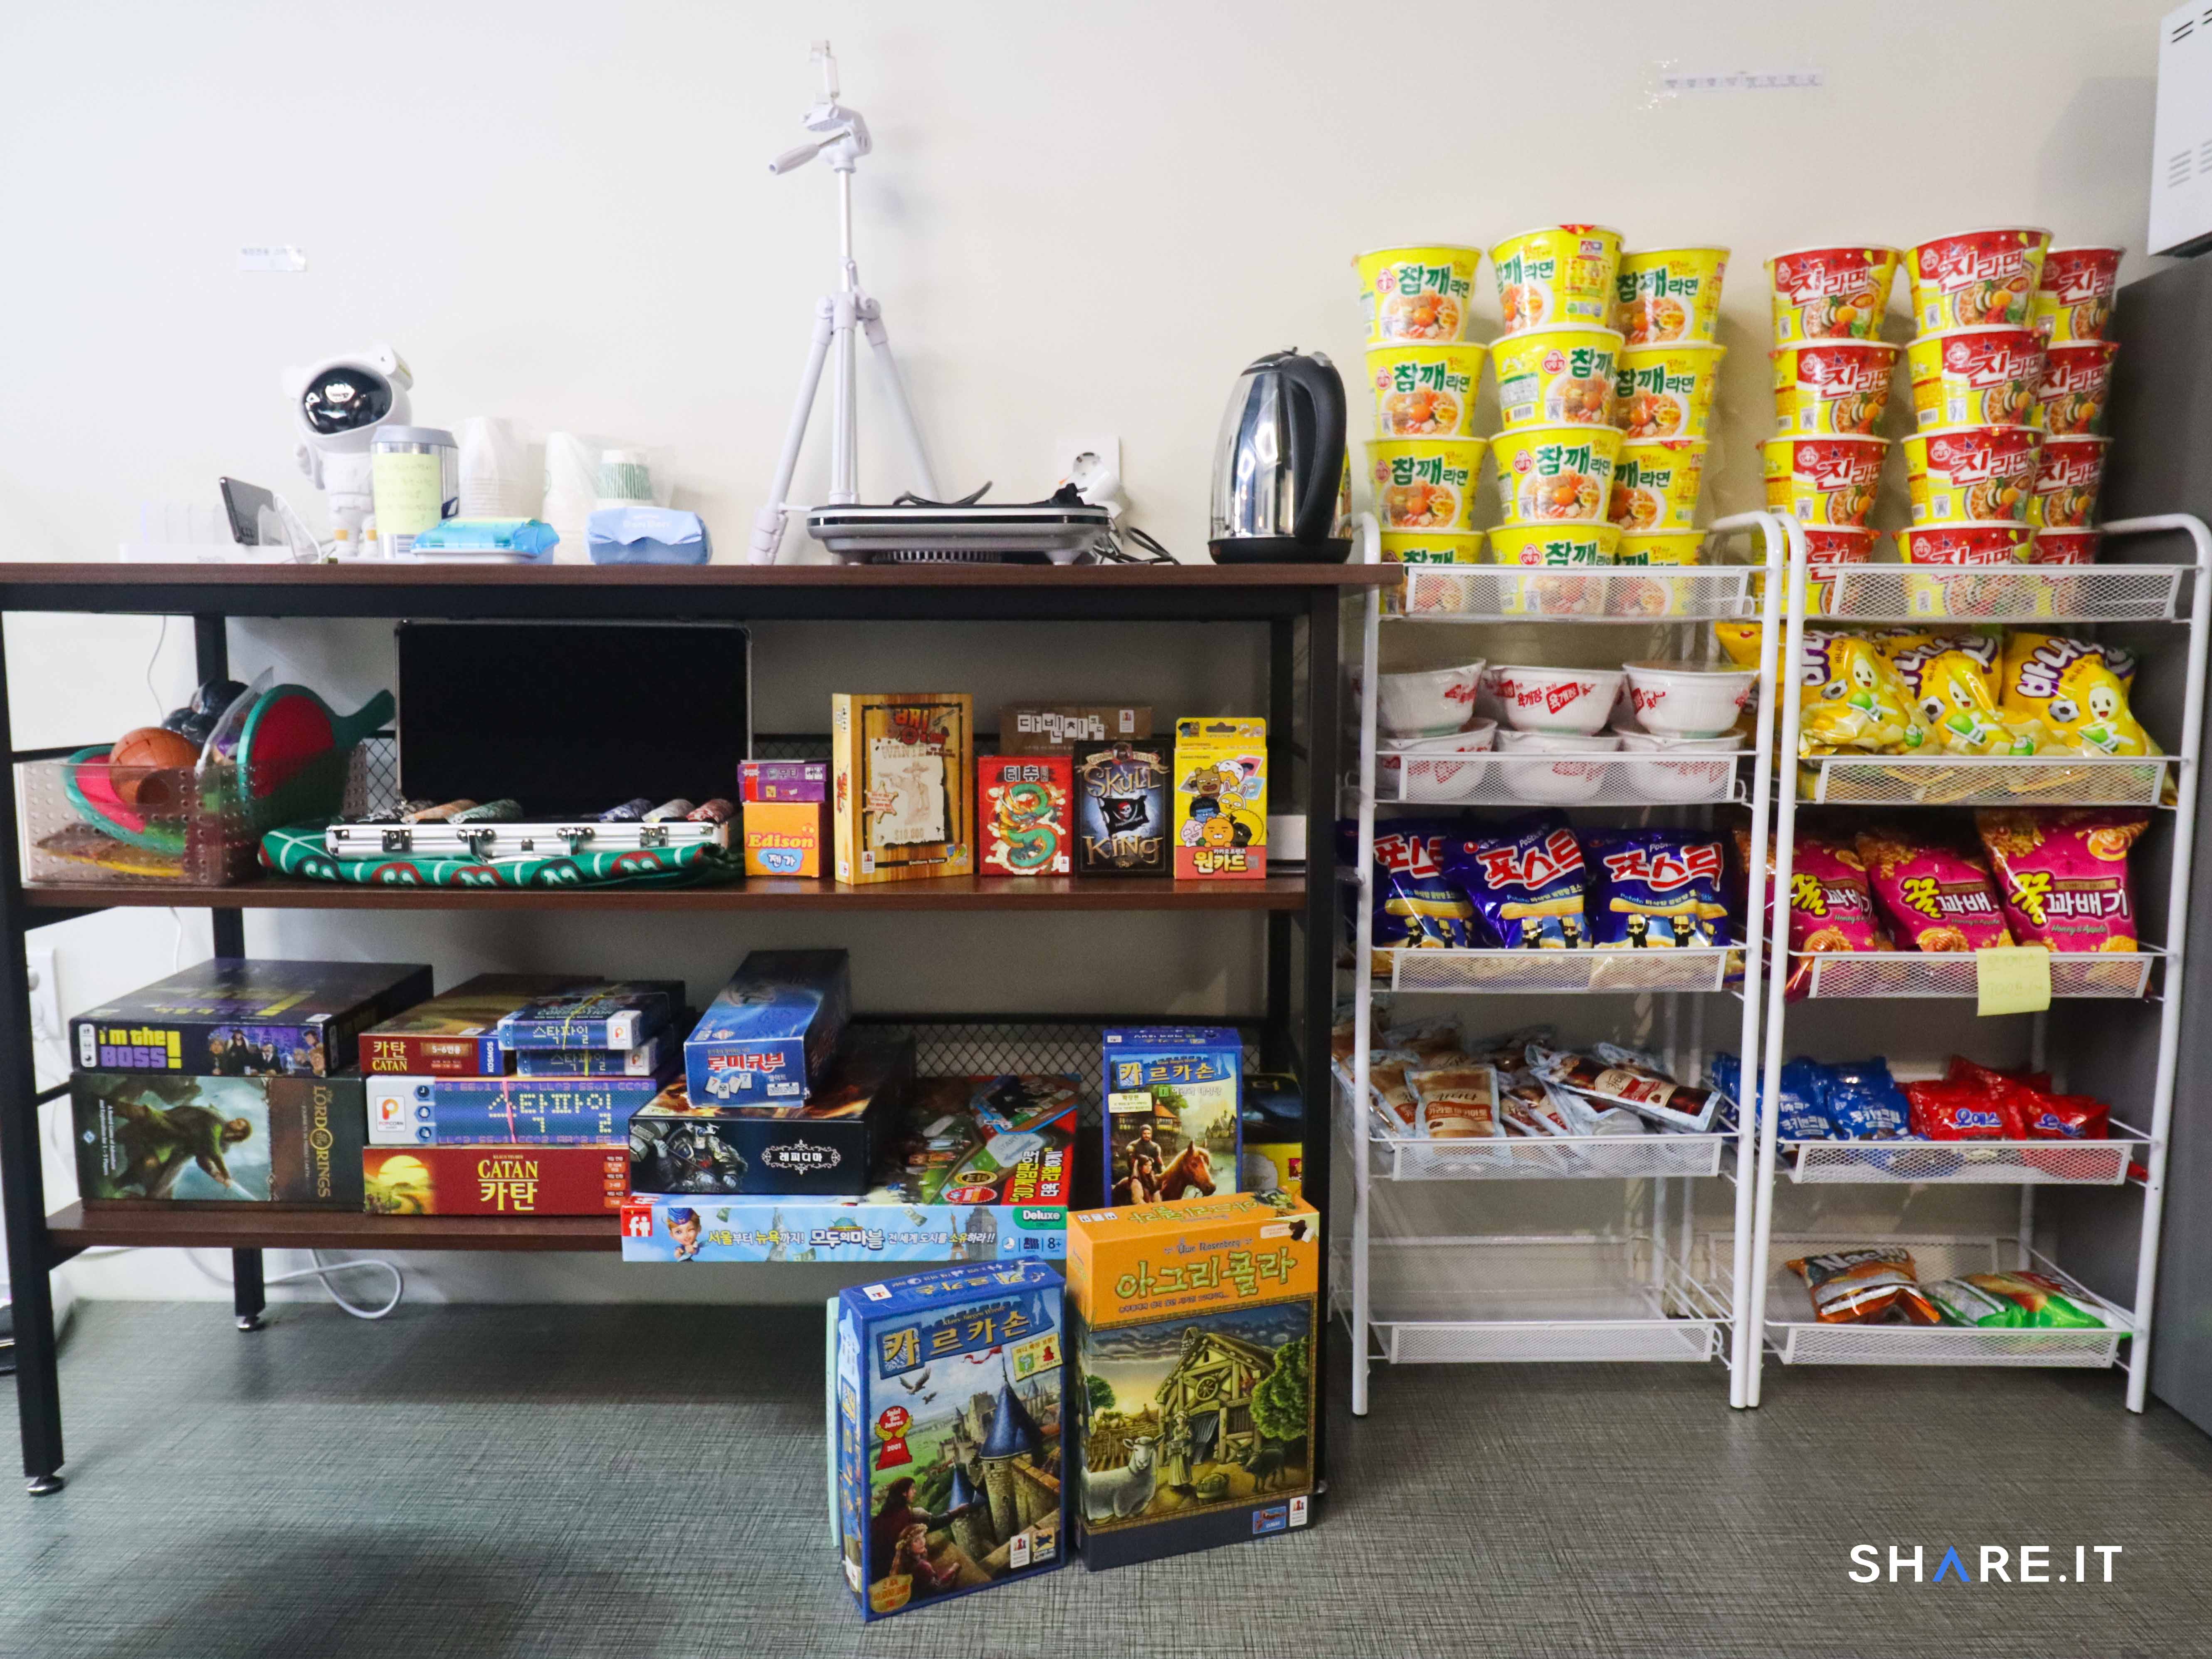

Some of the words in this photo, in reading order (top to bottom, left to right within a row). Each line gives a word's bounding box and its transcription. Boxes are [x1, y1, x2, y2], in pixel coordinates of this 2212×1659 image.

[1398, 265, 1470, 299] 참깨라면
[1938, 250, 2024, 295] 진라면
[1617, 269, 1698, 304] 참깨라면
[1790, 267, 1868, 308] 진라면
[2057, 269, 2116, 308] 진라
[1570, 348, 1617, 380] 참깨
[1394, 362, 1470, 393] 참깨라면
[1616, 363, 1695, 398] 참깨라면
[1392, 457, 1468, 487] 참깨라면
[1536, 444, 1611, 477] 참깨라면
[1615, 460, 1671, 488] 깨라면
[1549, 687, 1577, 710] 육개장
[881, 744, 926, 758] WANTE
[1004, 765, 1039, 781] 티츄
[748, 834, 814, 848] Edison
[768, 852, 796, 866] 젠가
[1193, 851, 1249, 874] 원카드
[1603, 842, 1723, 892] 포스틱
[1903, 878, 2000, 918] 꿀꽈배
[2010, 872, 2128, 924] 꿀꽈배기
[130, 1027, 165, 1046] the
[373, 1041, 407, 1059] 카탄
[372, 1060, 408, 1071] CATAN
[708, 1052, 785, 1073] 루미큐브
[1119, 1062, 1215, 1086] 카르카손
[1198, 1087, 1222, 1096] 대성당
[313, 1085, 328, 1129] LORD
[488, 1094, 612, 1133] 스탁파일
[1953, 1107, 2002, 1129] 오예스
[477, 1160, 538, 1179] CATAN
[779, 1152, 823, 1163] 레피디마
[316, 1150, 331, 1198] RINGS
[480, 1182, 538, 1211] 카탄
[1022, 1209, 1060, 1220] Deluxe
[709, 1230, 753, 1245] 서울부터
[755, 1229, 805, 1245] 뉴욕까지!
[810, 1229, 884, 1251] 모두의마블
[920, 1232, 947, 1244] 도시를
[1048, 1238, 1062, 1249] 8+
[1200, 1240, 1241, 1252] Rosenberg
[1115, 1247, 1298, 1298] 아그리콜라
[883, 1311, 1031, 1367] 카르카손
[884, 1421, 904, 1429] Jahres
[886, 1443, 902, 1452] 2001
